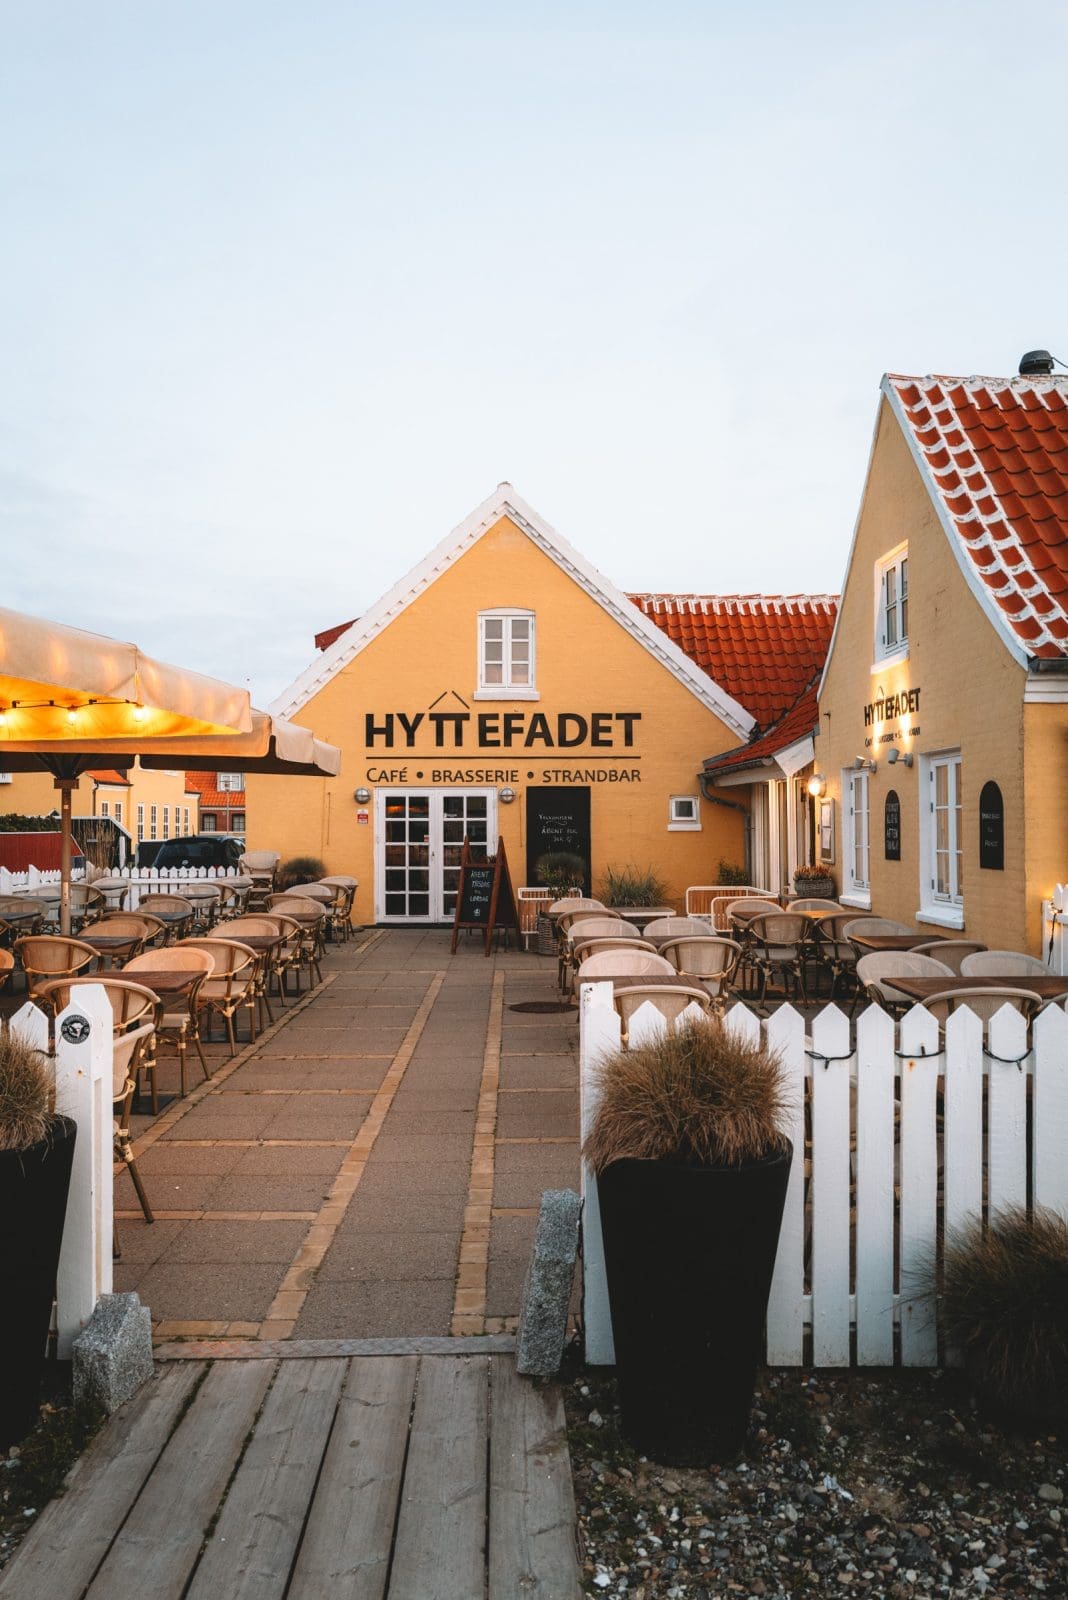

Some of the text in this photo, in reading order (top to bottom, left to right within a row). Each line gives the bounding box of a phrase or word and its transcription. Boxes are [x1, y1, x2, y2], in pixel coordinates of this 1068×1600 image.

[864, 687, 921, 727] HYTTEFADET
[365, 712, 642, 748] HYTTEFADET
[366, 766, 641, 783] CAFÉ BRASSERIE STRANDBAR
